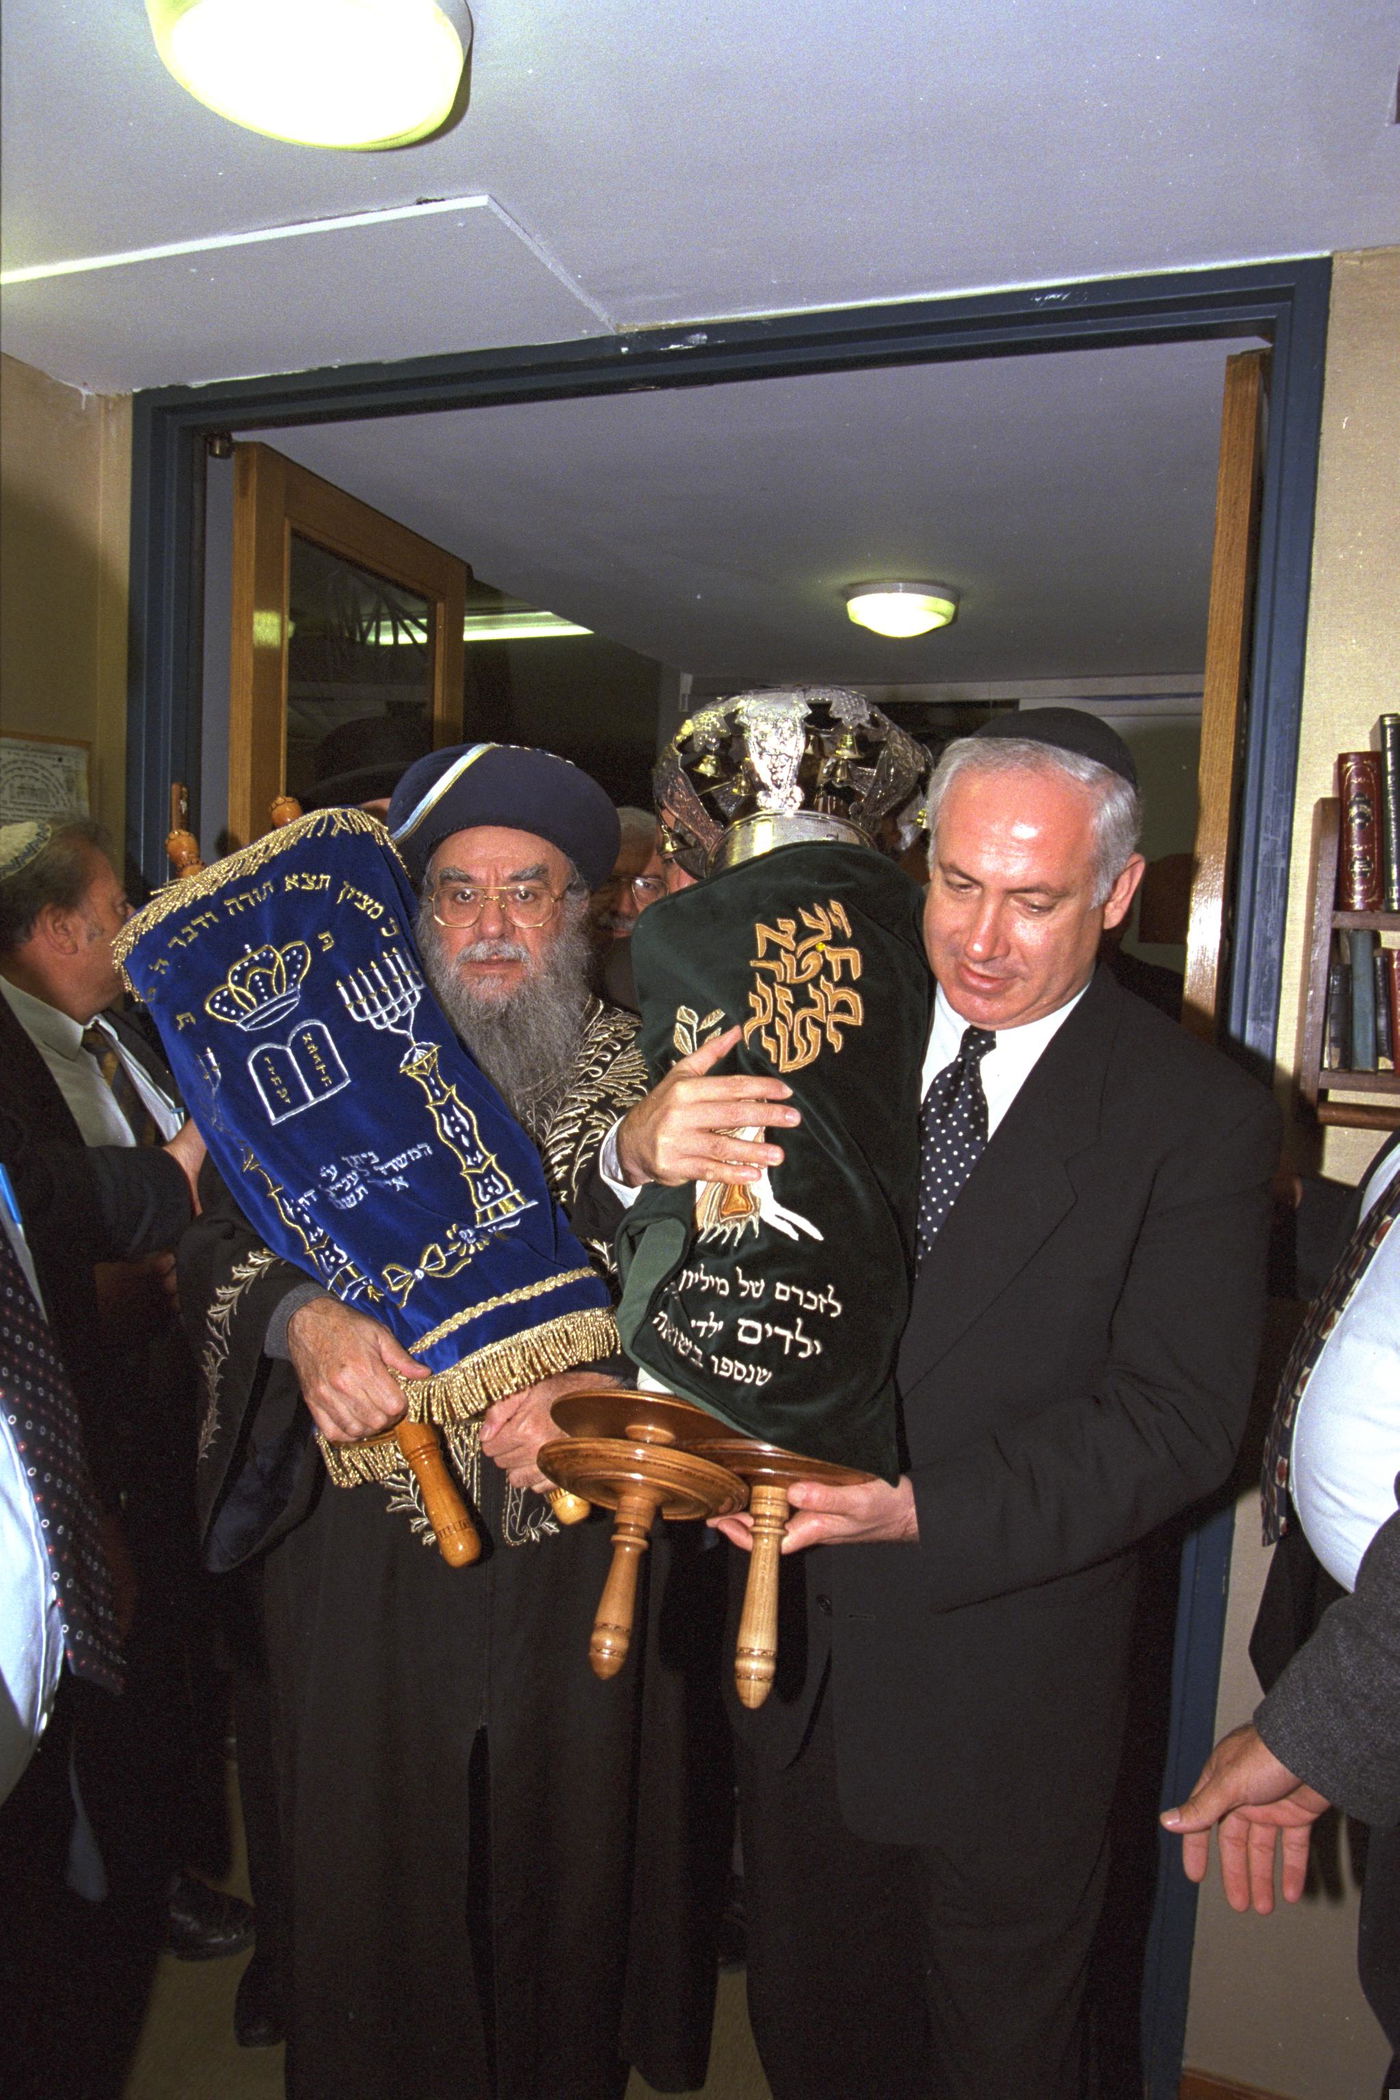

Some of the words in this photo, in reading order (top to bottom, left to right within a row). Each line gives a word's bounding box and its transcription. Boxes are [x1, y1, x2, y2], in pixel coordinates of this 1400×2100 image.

[224, 881, 274, 916] תורה
[285, 873, 331, 892] תצא
[336, 880, 384, 919] מציון
[167, 911, 219, 948] ודבר
[678, 1263, 730, 1297] מיליון
[736, 1266, 766, 1299] של
[774, 1282, 842, 1318] לזכרם
[652, 1310, 704, 1369] בשואה
[690, 1311, 725, 1339] ילדי
[737, 1317, 823, 1359] ילדים
[710, 1353, 773, 1387] שנספו
